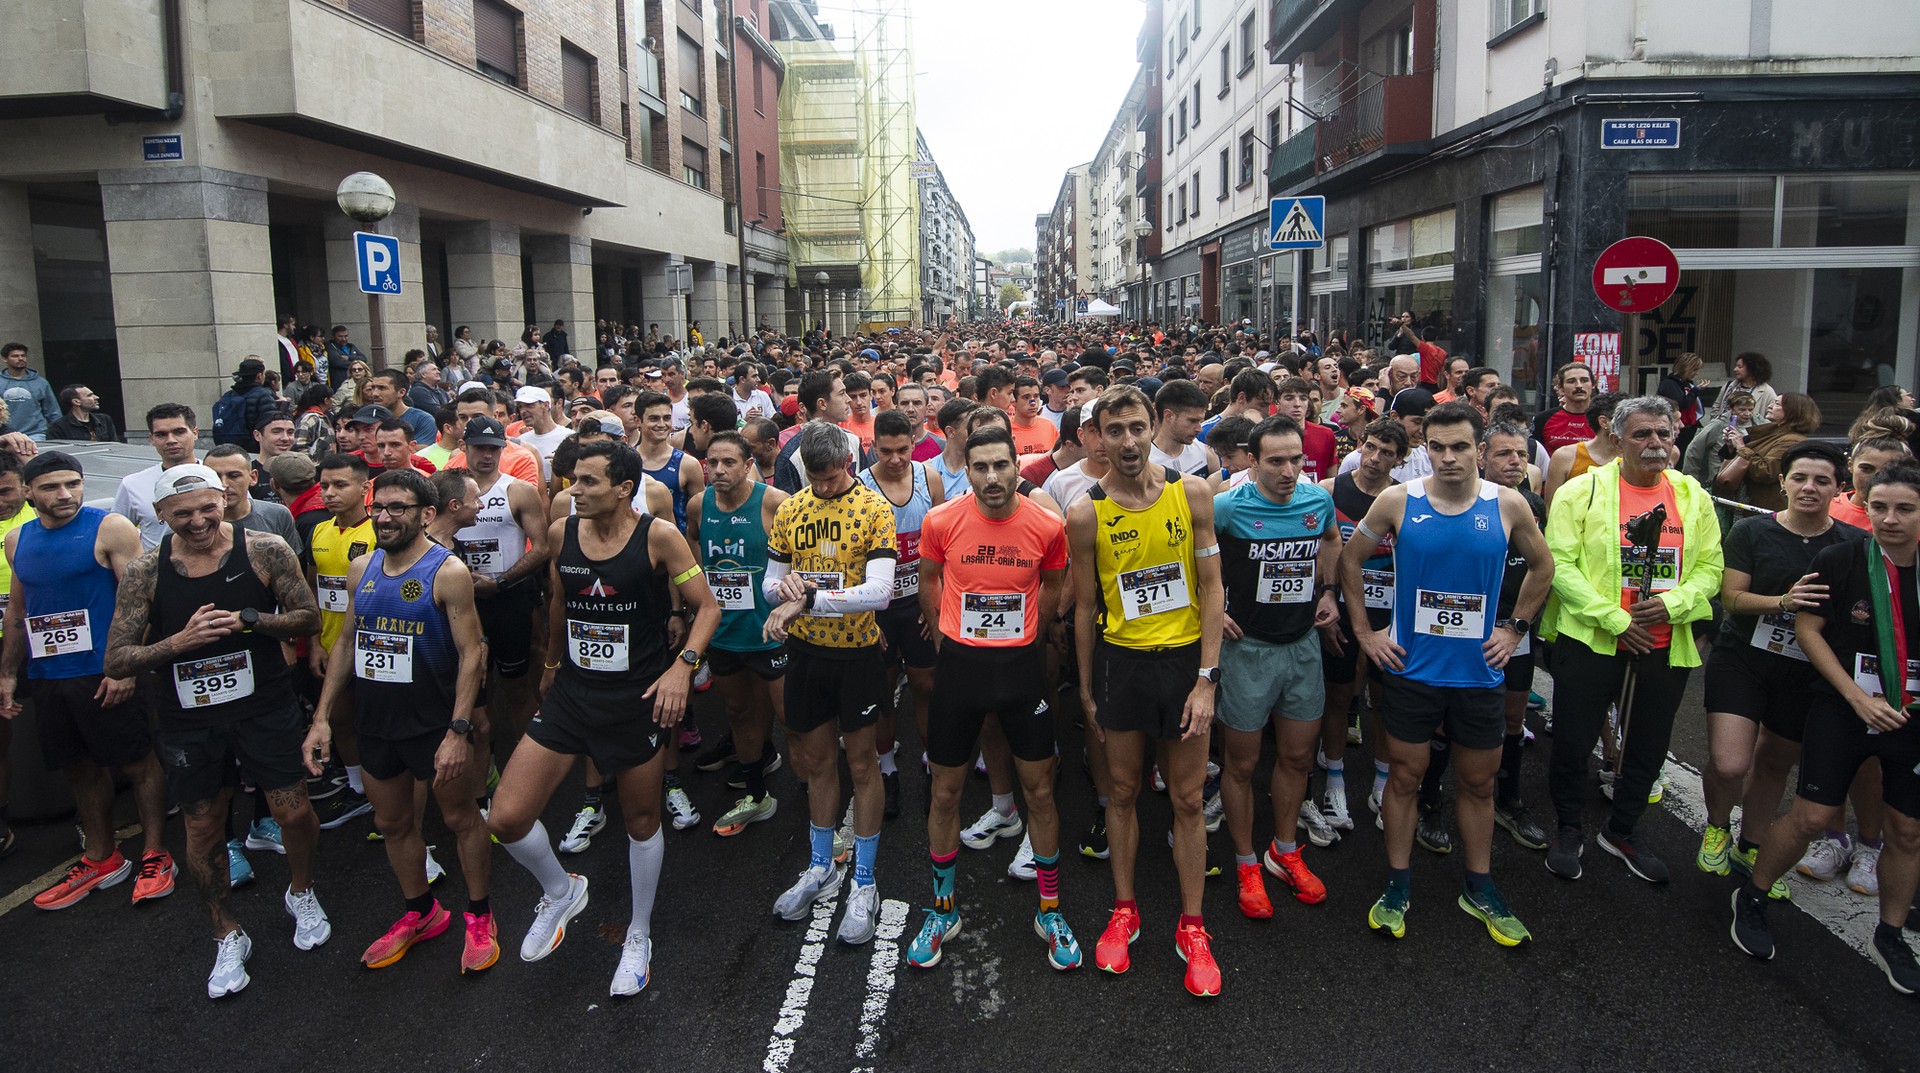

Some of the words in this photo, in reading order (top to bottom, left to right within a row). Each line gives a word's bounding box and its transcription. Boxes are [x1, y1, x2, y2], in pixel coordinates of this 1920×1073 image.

[366, 240, 391, 286] P
[1574, 333, 1619, 355] KOM
[794, 517, 841, 550] COMO
[1110, 529, 1139, 543] INDO
[960, 555, 1015, 567] LASARTE-ORIA
[560, 565, 590, 575] macron
[893, 574, 918, 590] 350
[1271, 579, 1304, 593] 503
[329, 590, 337, 602] 8
[716, 587, 742, 600] 436
[1135, 583, 1171, 604] 371
[375, 616, 425, 635] IRANZU
[980, 613, 1005, 628] 24
[1437, 611, 1464, 626] 68
[42, 628, 79, 646] 265
[579, 641, 615, 658] 820
[365, 652, 395, 669] 231
[192, 673, 238, 695] 395
